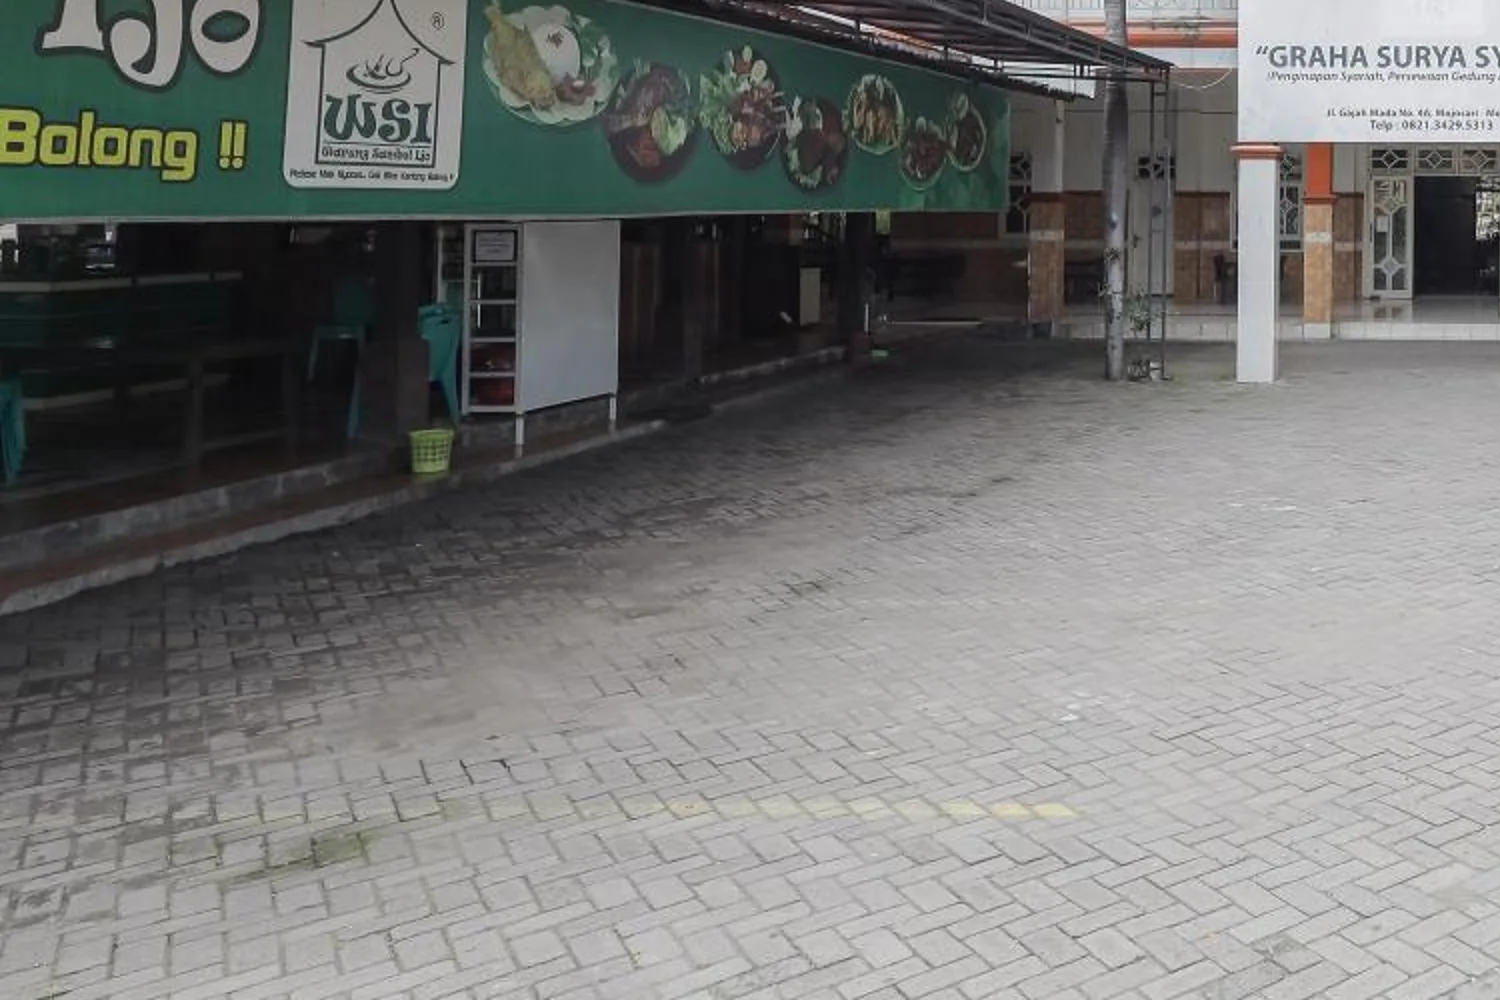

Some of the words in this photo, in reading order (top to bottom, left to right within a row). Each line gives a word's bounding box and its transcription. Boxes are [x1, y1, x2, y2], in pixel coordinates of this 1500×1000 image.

[1377, 45, 1467, 69] SURYA
[1341, 71, 1385, 83] Syariah,
[1388, 71, 1449, 82] Persewaan
[1452, 71, 1497, 84] Gedung
[324, 94, 432, 142] WSI
[1370, 108, 1397, 117] Mada
[1370, 119, 1393, 132] Telp
[1401, 119, 1493, 131] 0821.3429.5313
[0, 107, 198, 181] Bolong
[218, 120, 247, 169] !!
